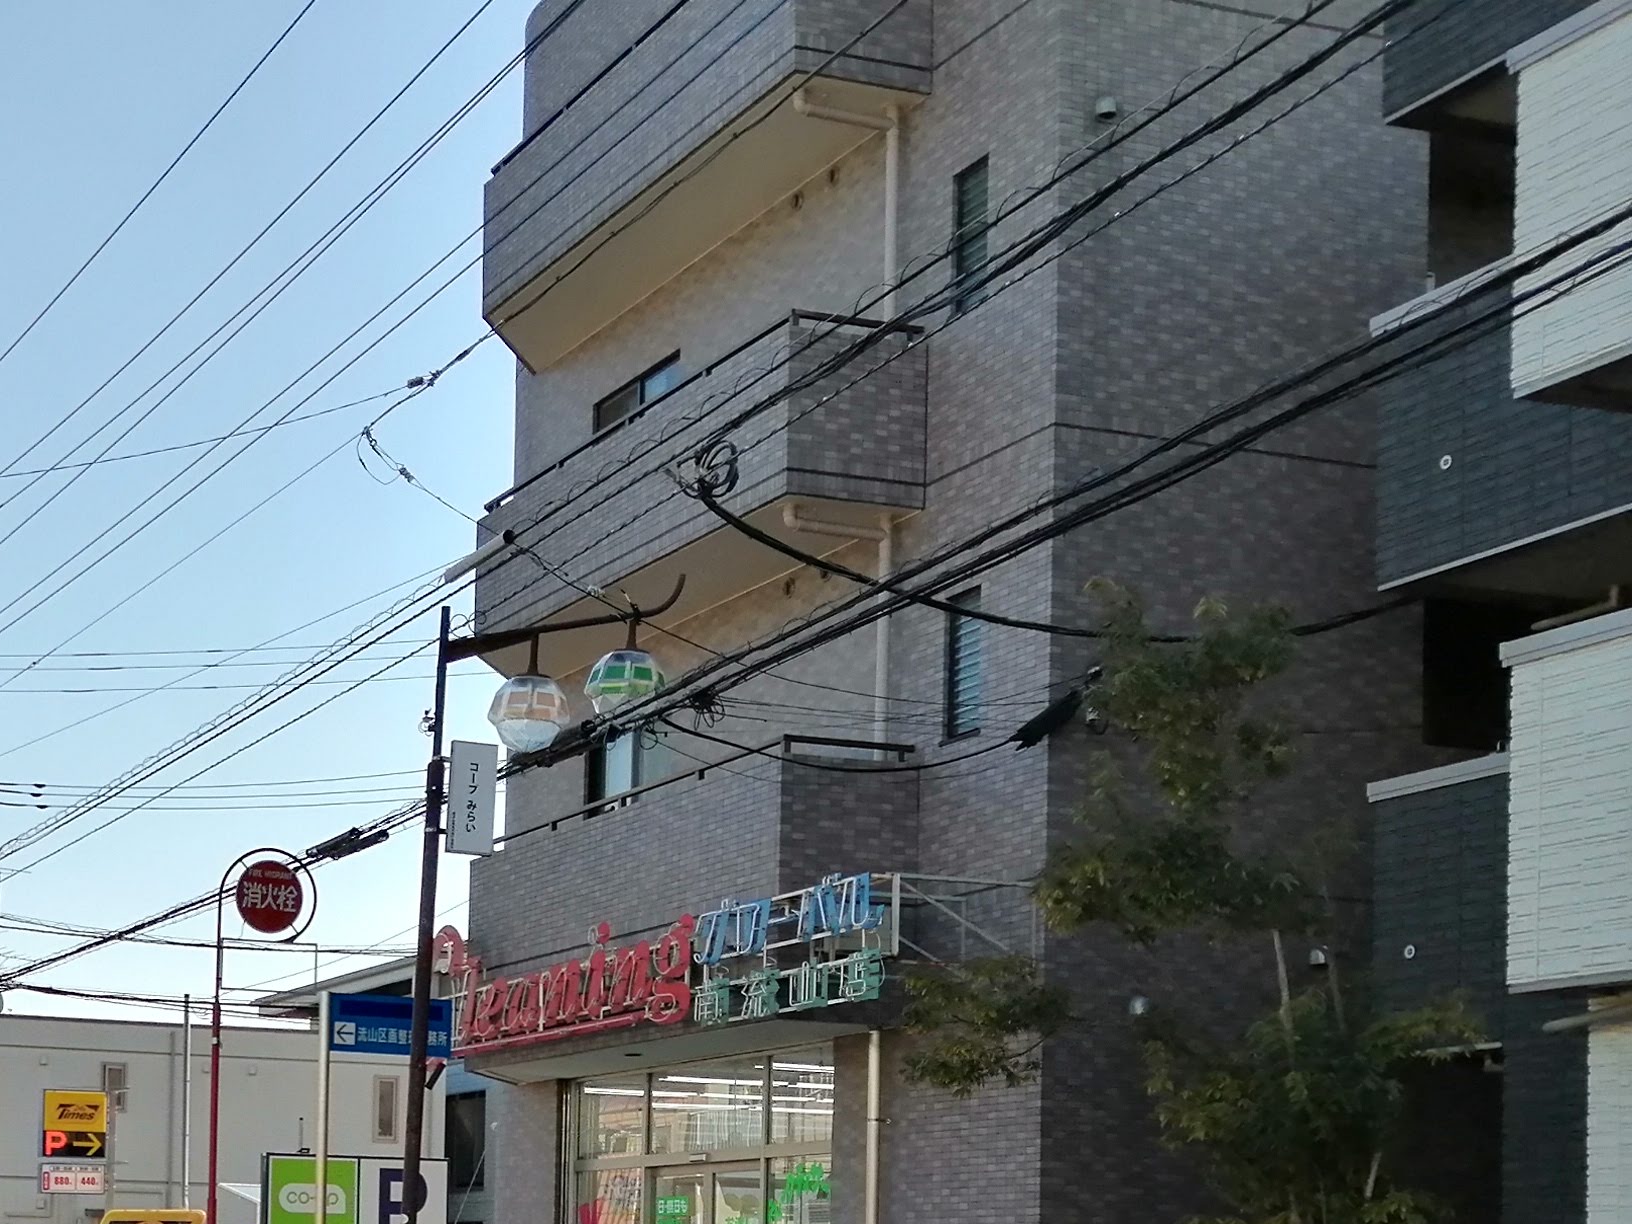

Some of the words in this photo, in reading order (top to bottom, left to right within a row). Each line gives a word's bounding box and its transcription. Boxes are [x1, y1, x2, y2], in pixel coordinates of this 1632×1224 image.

[242, 881, 298, 913] 消火栓
[357, 1026, 448, 1047] 流山区画整務所
[57, 1103, 96, 1121] Times
[45, 1131, 67, 1156] P
